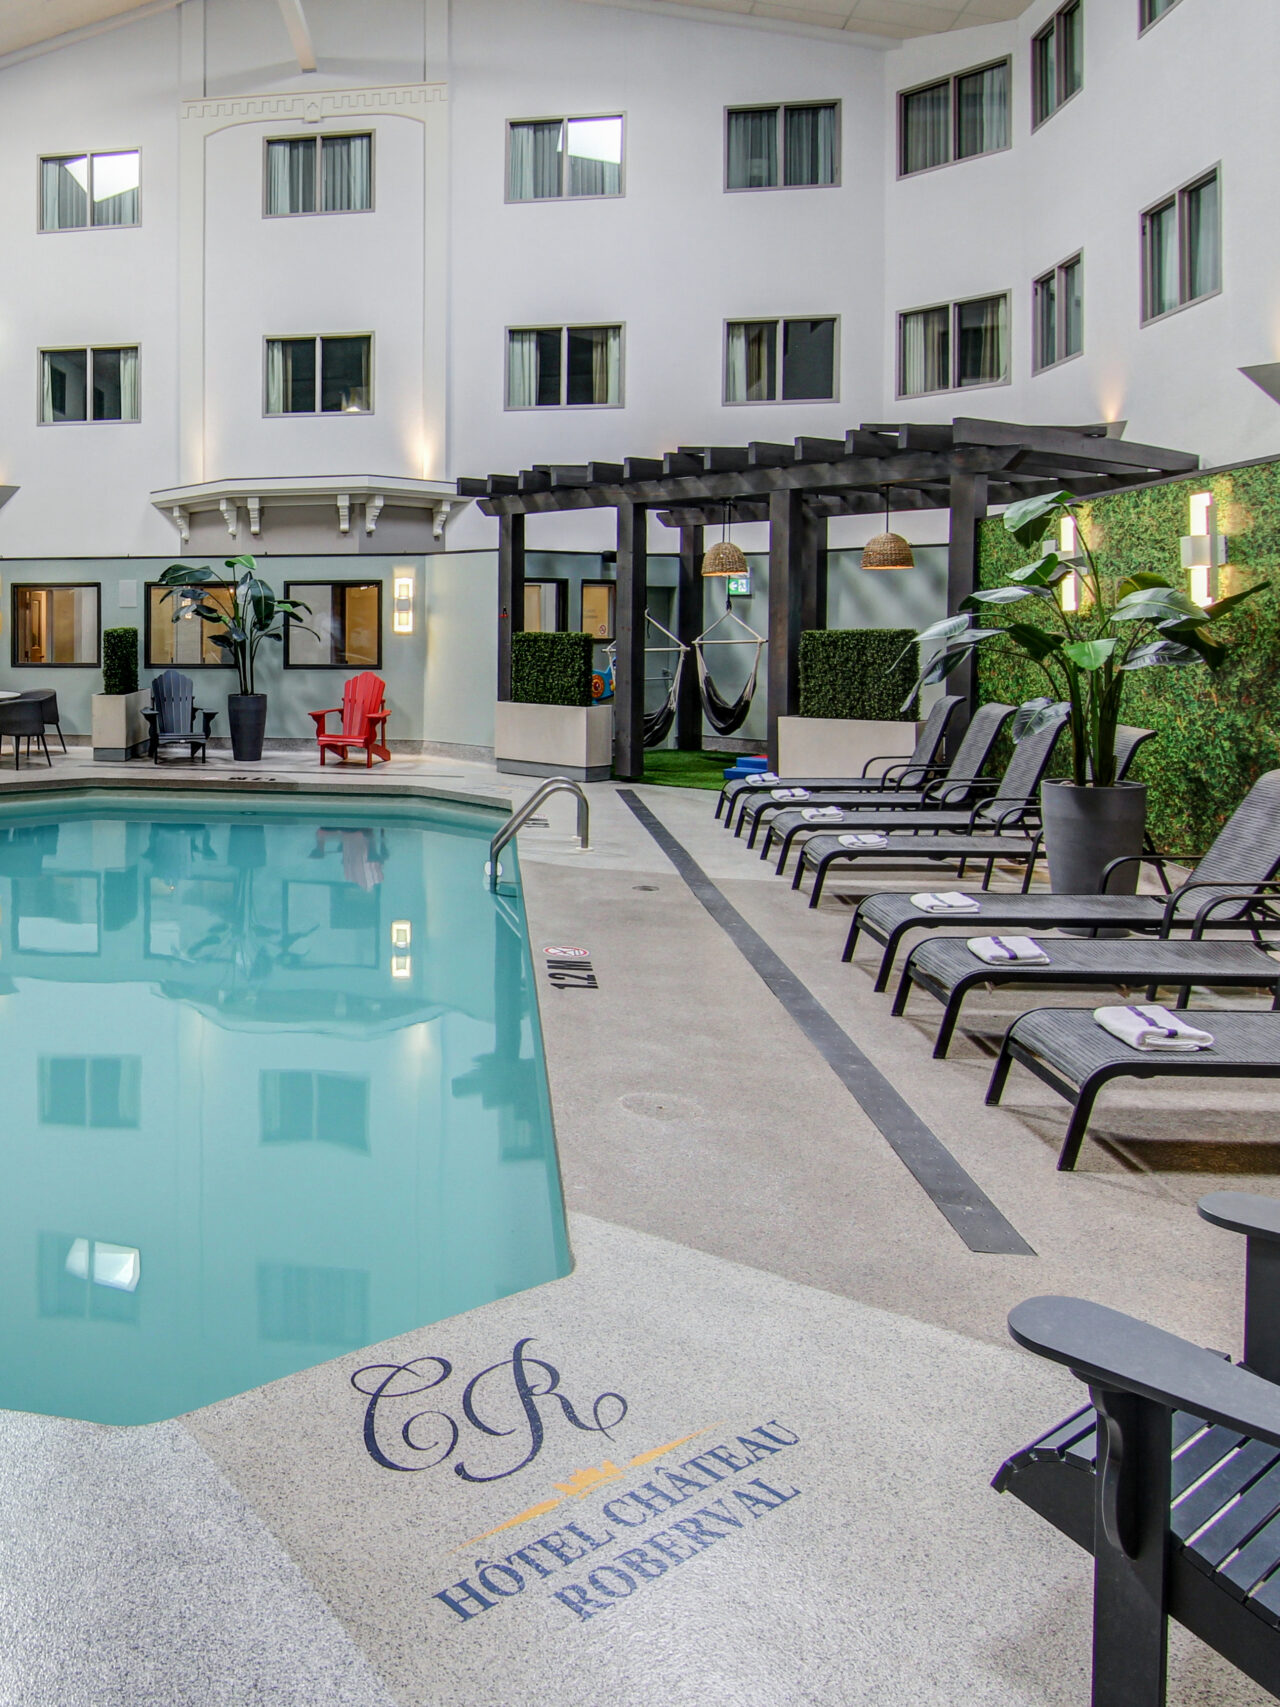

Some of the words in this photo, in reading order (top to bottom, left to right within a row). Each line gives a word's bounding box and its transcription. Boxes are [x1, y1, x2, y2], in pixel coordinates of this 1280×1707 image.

[431, 1520, 615, 1623] HÔTEL
[602, 1418, 803, 1529] CHÂTEAU
[552, 1477, 802, 1623] ROBERVAL
